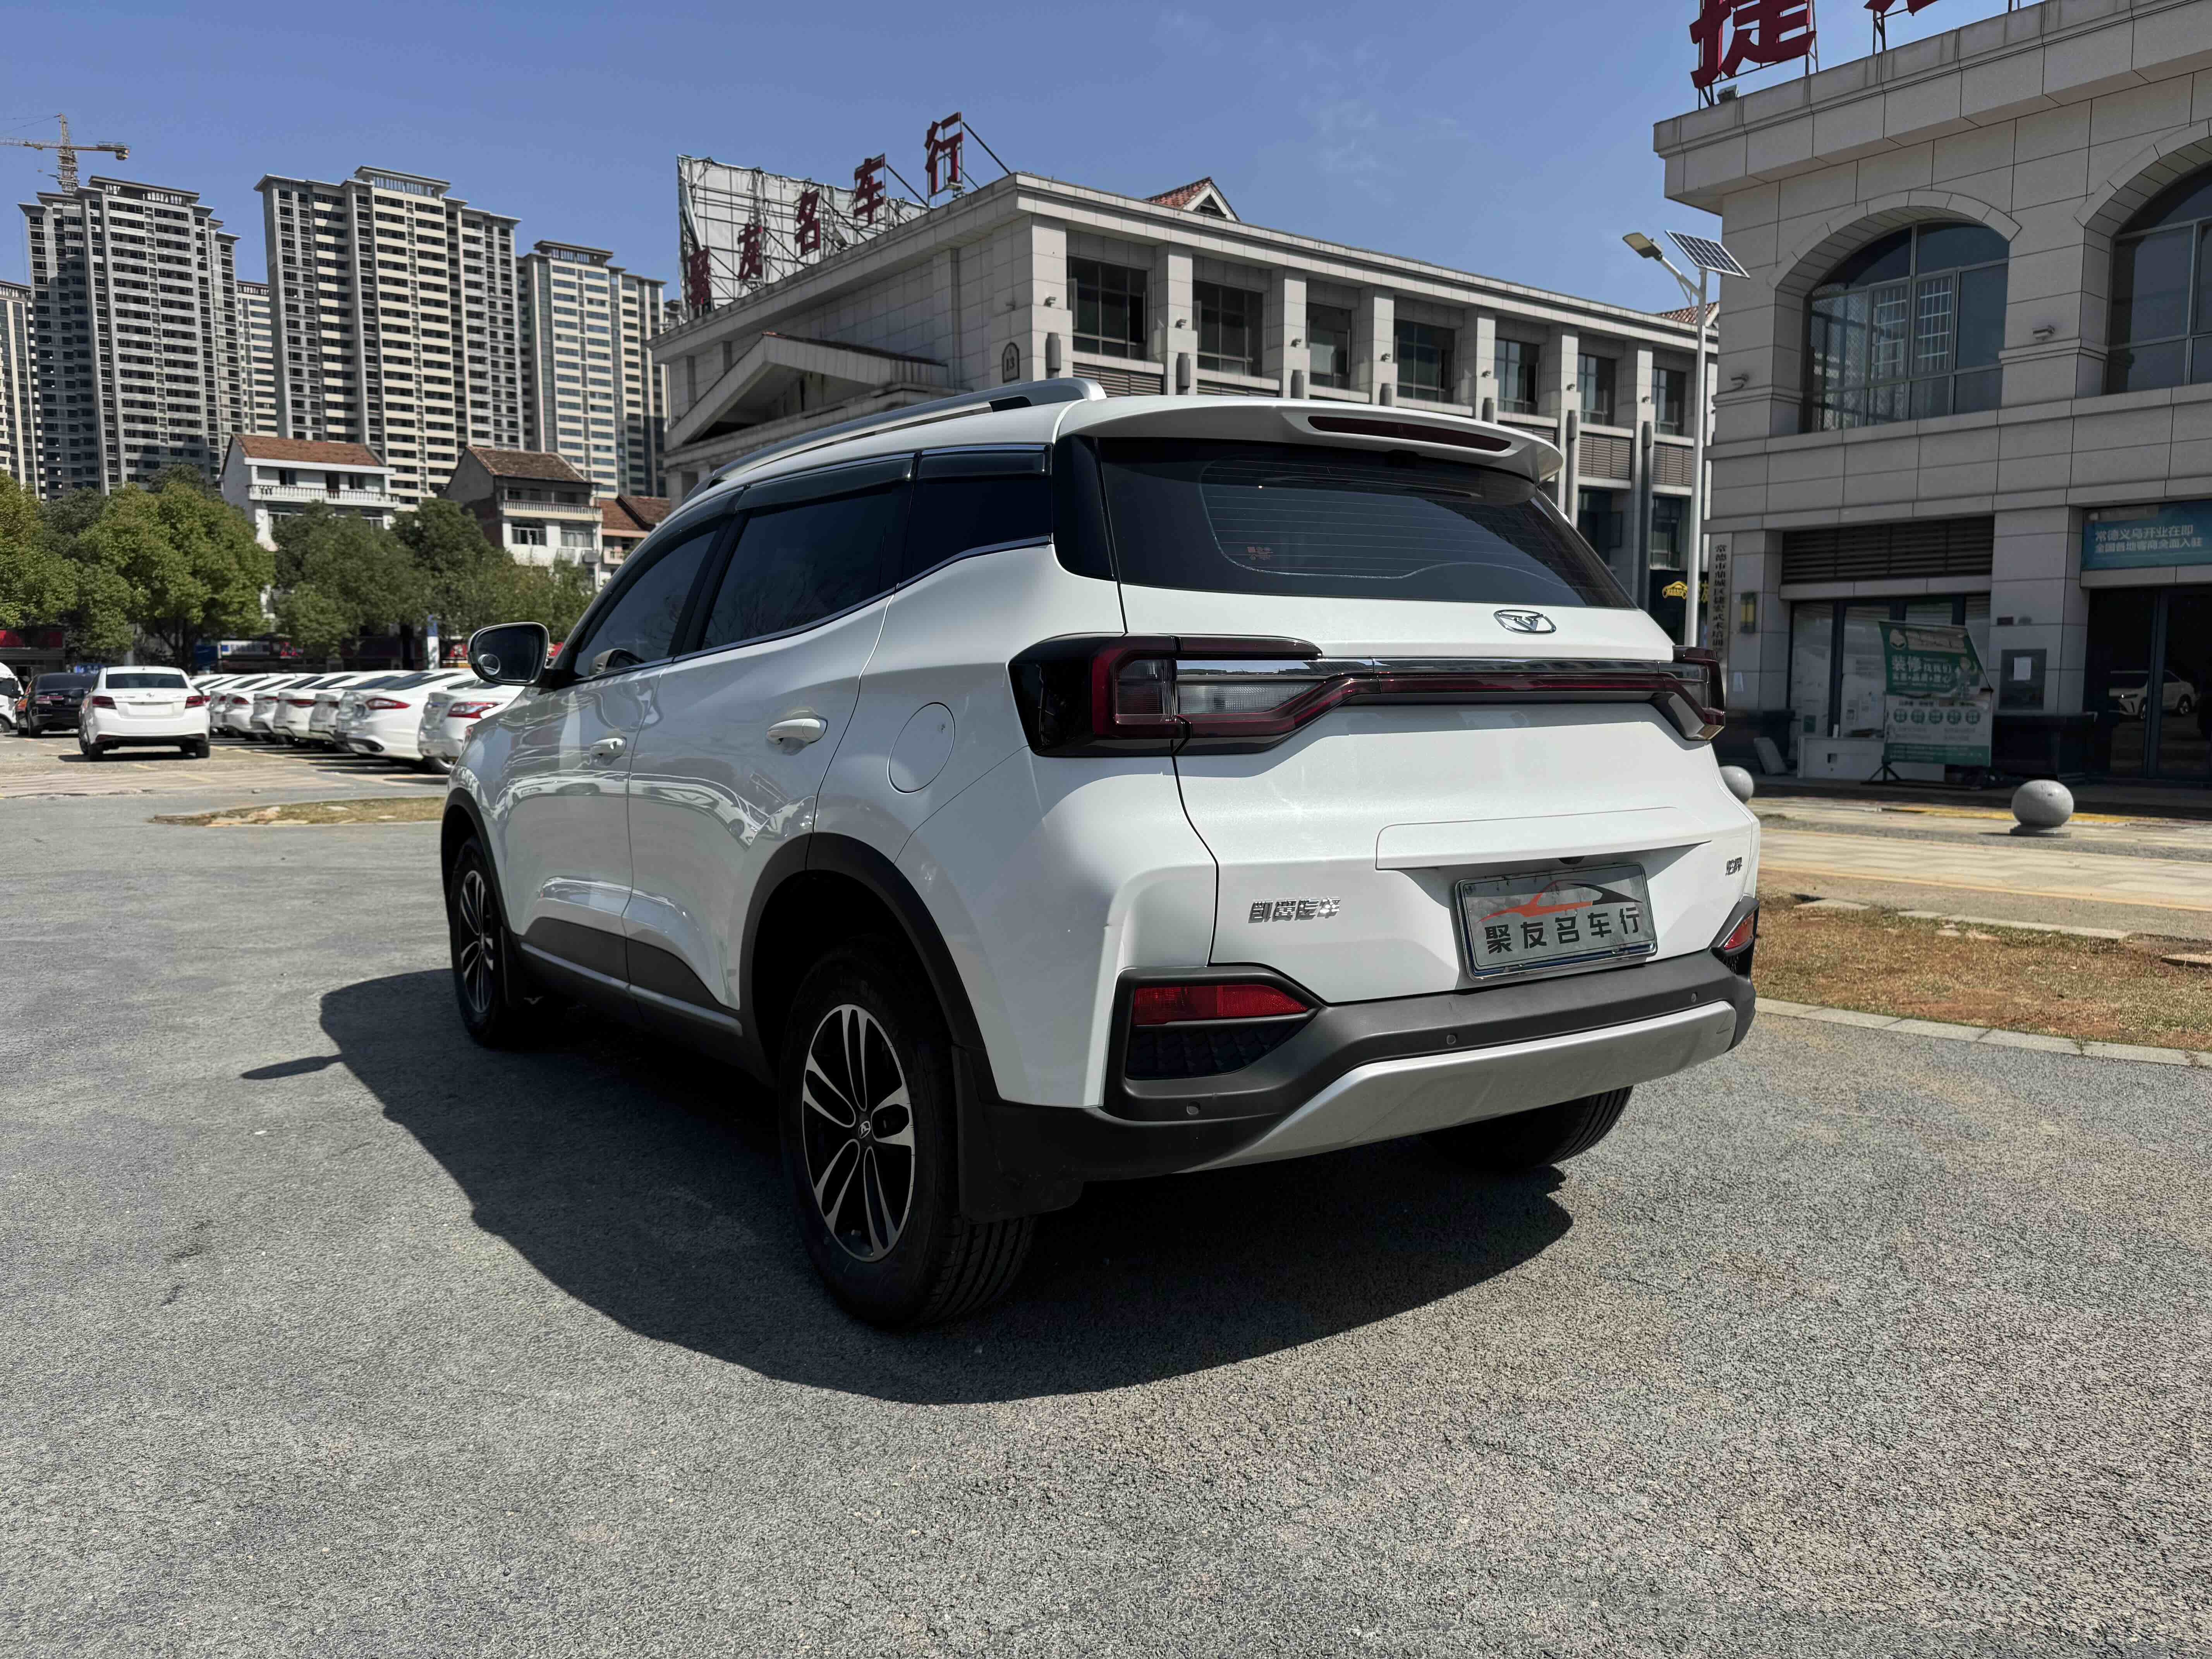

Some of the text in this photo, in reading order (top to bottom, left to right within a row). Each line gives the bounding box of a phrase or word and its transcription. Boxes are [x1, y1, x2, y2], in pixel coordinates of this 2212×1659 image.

[689, 112, 963, 309] 聚友名车行
[2095, 524, 2193, 542] 常德义乌开业在即
[1248, 896, 1341, 924] 凯翼汽车
[1484, 907, 1642, 955] 聚友名车行
